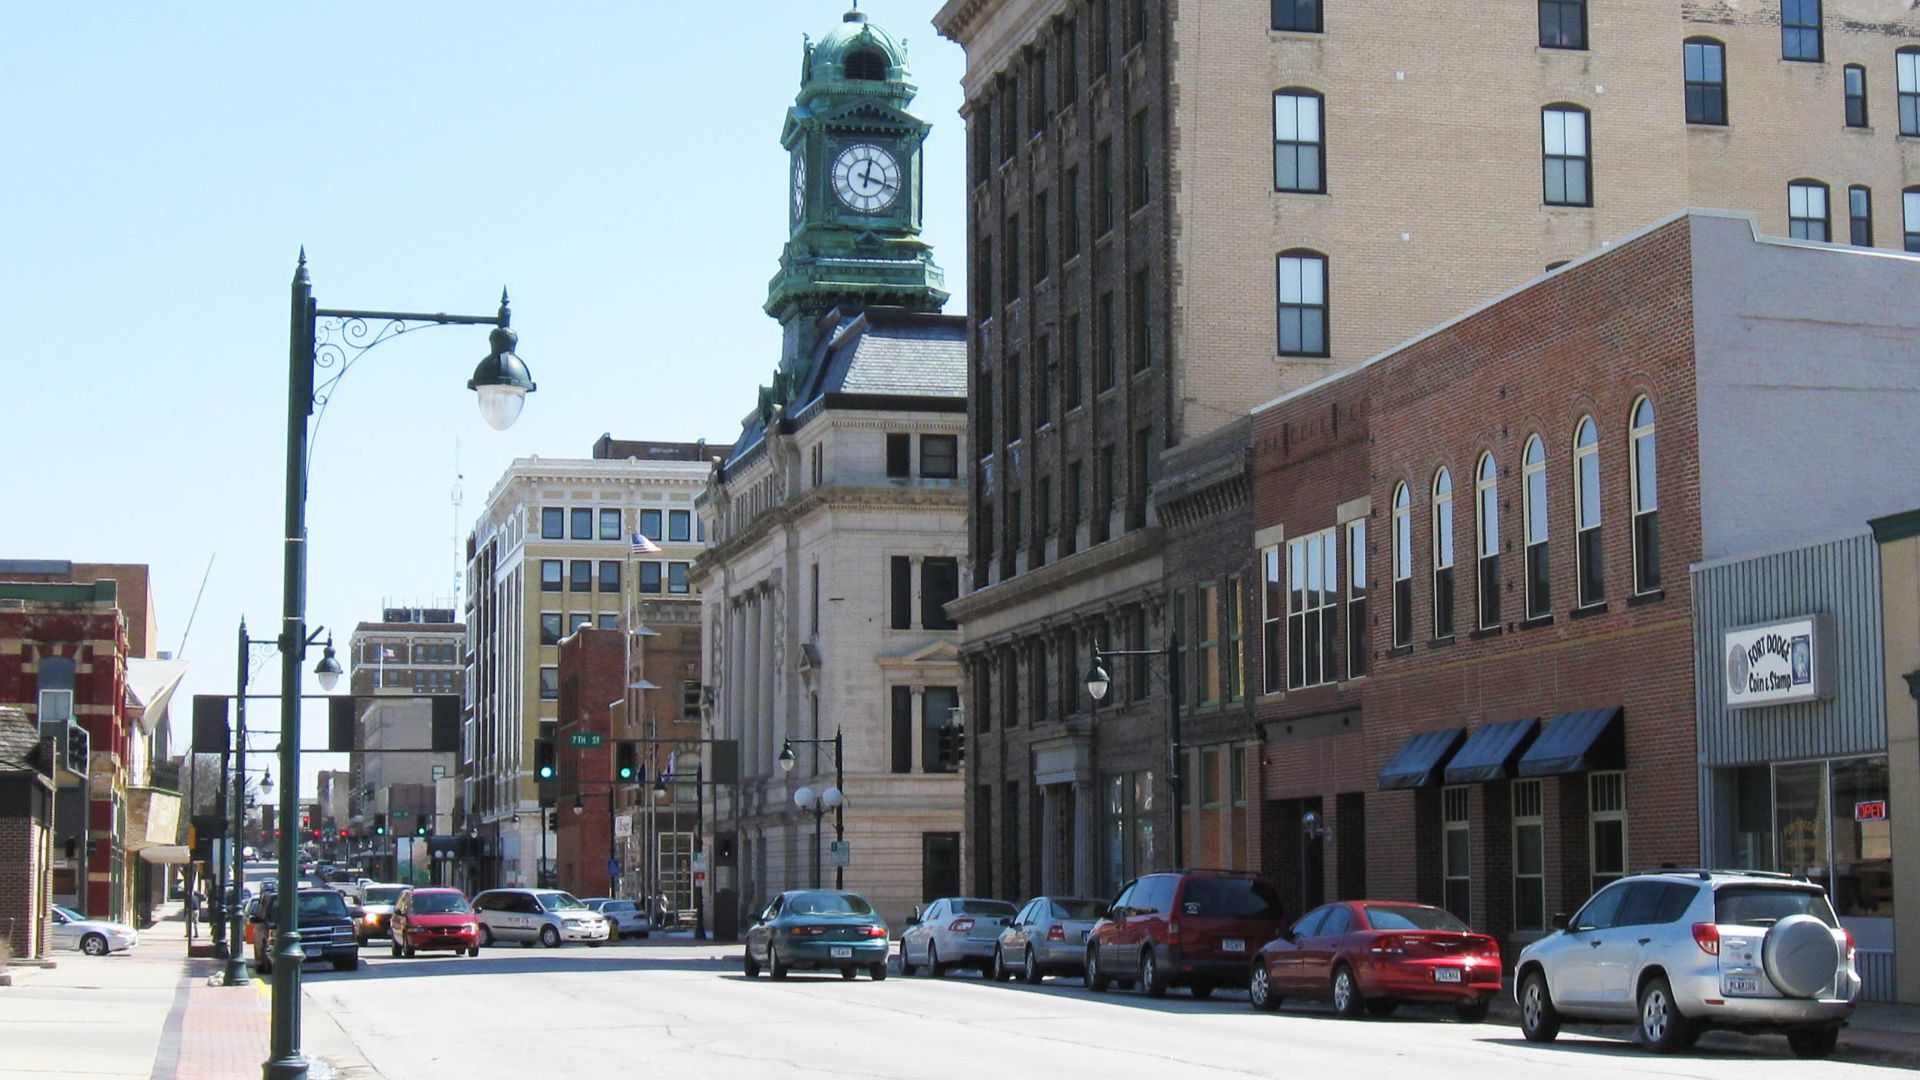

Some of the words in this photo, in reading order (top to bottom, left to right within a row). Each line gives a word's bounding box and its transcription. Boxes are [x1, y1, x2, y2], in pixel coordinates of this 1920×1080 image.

[1748, 636, 1765, 668] FORT
[1767, 634, 1790, 662] DODGE
[1749, 672, 1764, 693] Coin
[1769, 671, 1791, 692] Stamp
[572, 735, 586, 745] 7TH
[1857, 803, 1883, 818] OPEN
